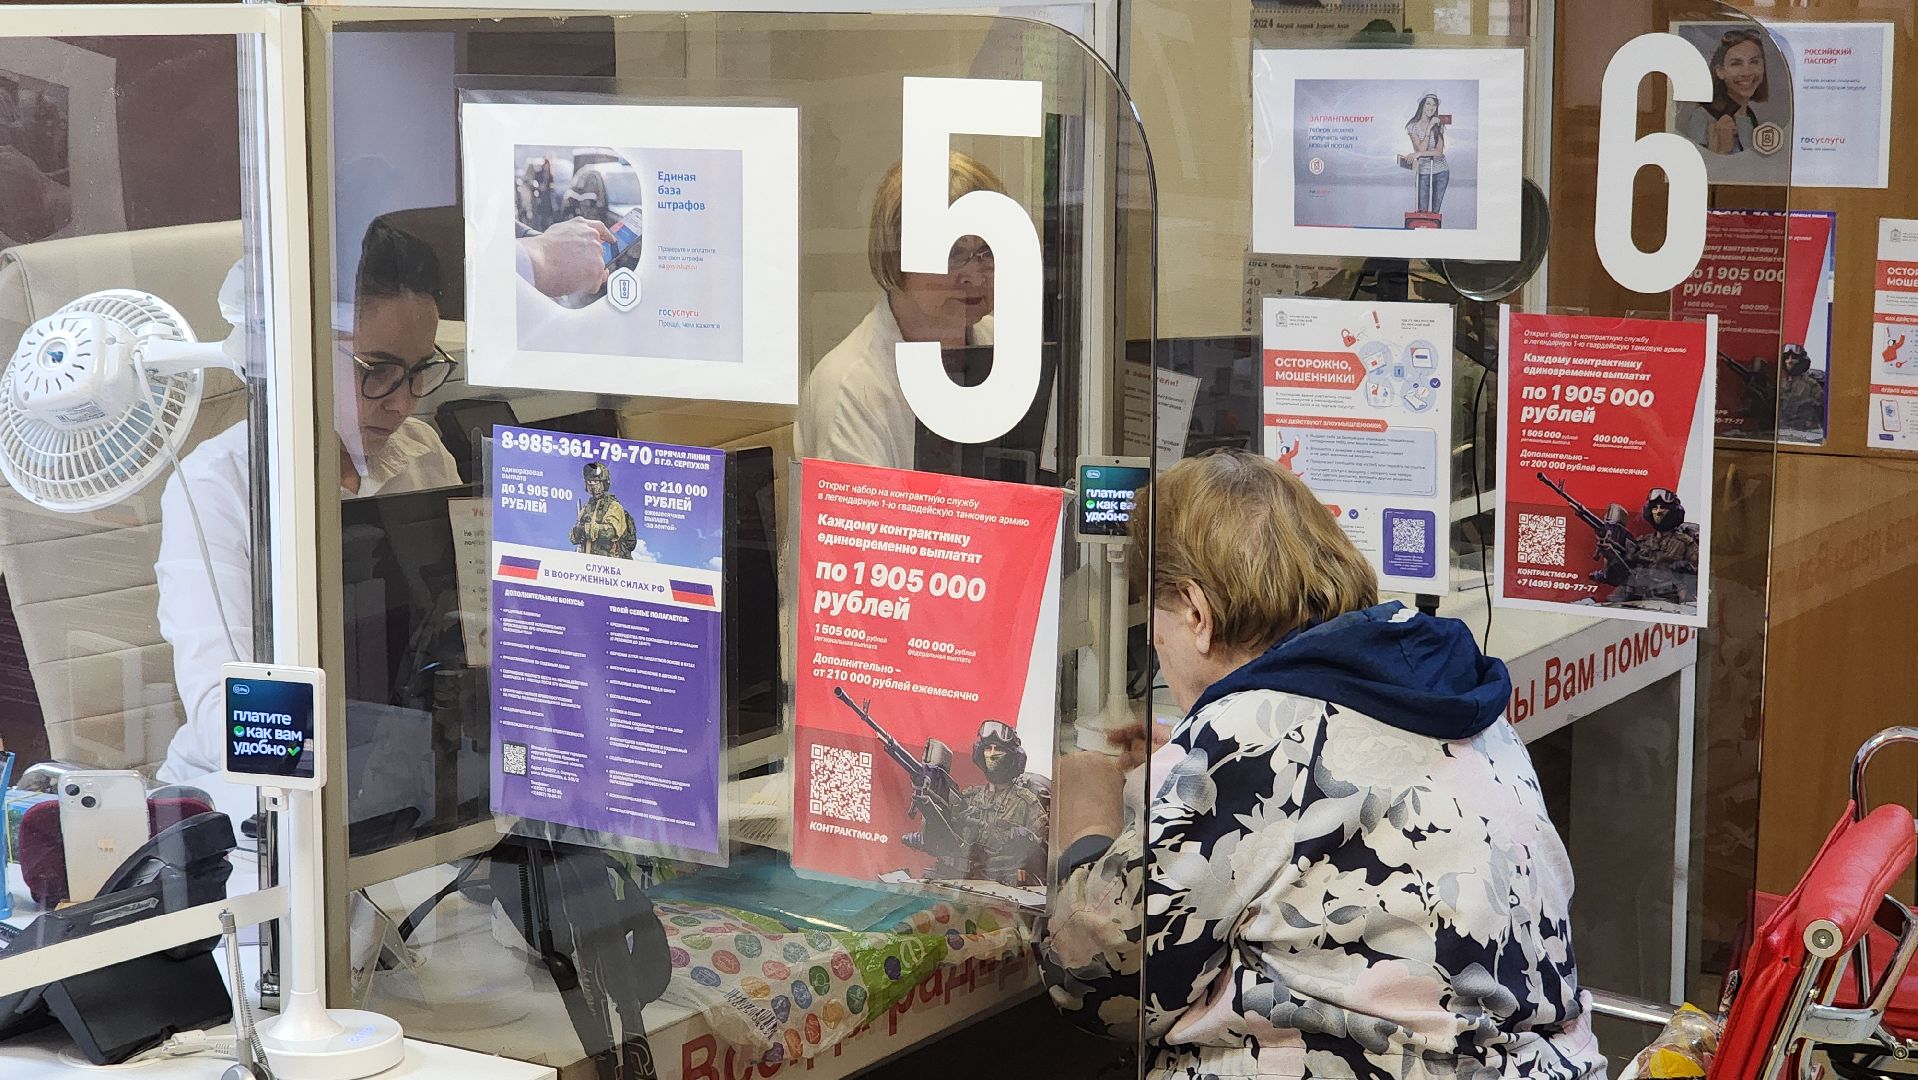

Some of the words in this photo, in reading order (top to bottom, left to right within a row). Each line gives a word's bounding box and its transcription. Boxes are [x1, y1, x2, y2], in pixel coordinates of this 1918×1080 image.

[1310, 115, 1375, 123] ЗАГРАНПАСПОРТ
[1595, 33, 1714, 293] 6
[658, 171, 696, 182] Единая
[658, 185, 682, 195] база
[658, 200, 706, 212] штрафов
[895, 77, 1043, 443] 5
[1706, 266, 1714, 279] 1
[1717, 268, 1750, 281] 905
[1682, 282, 1742, 296] рублей
[1524, 329, 1549, 338] Открыт
[1550, 332, 1570, 340] набор
[1580, 334, 1623, 342] контрактную
[1624, 336, 1650, 344] службу
[1529, 340, 1572, 348] легендарную
[1586, 343, 1630, 351] гвардейскую
[1630, 345, 1663, 353] танковую
[1275, 357, 1352, 372] ОСТОРОЖНО,
[1524, 353, 1572, 366] Каждому
[1572, 358, 1642, 370] контрактнику
[1276, 371, 1354, 384] МОШЕННИКИ!
[1524, 366, 1602, 378] единовременно
[1602, 372, 1652, 382] выплатят
[1522, 385, 1547, 400] по
[1552, 384, 1562, 400] 1
[1564, 385, 1606, 404] 905
[1610, 388, 1655, 408] 000
[1520, 404, 1596, 424] рублей
[1592, 434, 1612, 443] 400
[1611, 436, 1630, 444] 000
[502, 431, 652, 466] 8-985-361-79-70
[654, 449, 686, 459] ГОРЯЧАЯ
[687, 452, 711, 462] ЛИНИЯ
[1520, 449, 1582, 460] Дополнительно
[674, 460, 710, 470] СЕРПУХОВ
[1531, 460, 1548, 468] 200
[1548, 461, 1566, 470] 000
[1566, 463, 1596, 472] рублей
[1596, 466, 1648, 476] ежемесячно
[502, 484, 516, 494] до
[518, 483, 525, 494] 1
[526, 484, 549, 498] 905
[550, 487, 572, 500] 000
[644, 482, 658, 491] от
[660, 481, 682, 494] 210
[684, 484, 708, 497] 000
[818, 480, 850, 492] Открыт
[851, 484, 878, 497] набор
[878, 488, 889, 497] на
[890, 490, 946, 504] контрактную
[946, 496, 980, 510] службу
[1086, 488, 1135, 500] платите
[502, 496, 547, 514] РУБЛЕЙ
[644, 495, 692, 511] РУБЛЕЙ
[824, 494, 880, 508] легендарную
[881, 500, 896, 510] 1-ю
[898, 503, 954, 517] гвардейскую
[956, 510, 997, 524] танковую
[998, 515, 1030, 528] армию
[1096, 500, 1118, 510] как
[1085, 510, 1129, 523] удобно
[818, 514, 878, 536] Каждому
[879, 525, 971, 548] контрактнику
[818, 532, 918, 555] единовременно
[919, 547, 982, 564] выплатят
[585, 563, 622, 576] СЛУЖБА
[1517, 567, 1578, 580] КОНТРАКТМО.РФ
[544, 569, 550, 577] В
[551, 570, 618, 587] ВООРУЖЕННЫХ
[620, 579, 650, 592] СИЛАХ
[651, 584, 665, 593] РФ
[816, 560, 848, 582] по
[852, 561, 866, 586] 1
[870, 563, 924, 593] 905
[928, 572, 986, 602] 000
[1517, 578, 1528, 588] +7
[1528, 578, 1552, 590] (495)
[504, 589, 558, 603] ДОПОЛНИТЕЛЬНЫЕ
[558, 596, 585, 607] БОНУСЫ:
[813, 588, 911, 622] рублей
[609, 605, 629, 614] ТВОЕЙ
[629, 608, 650, 618] СЕМЬЕ
[650, 611, 690, 623] ПОЛАГАЕТСЯ:
[814, 634, 854, 647] региональная
[853, 641, 878, 650] выплата
[815, 624, 820, 634] 1
[821, 624, 844, 637] 505
[843, 628, 866, 640] 000
[866, 635, 888, 644] рублей
[907, 638, 931, 650] 400
[931, 641, 955, 654] 000
[954, 648, 977, 658] рублей
[813, 652, 894, 674] Дополнительно
[907, 649, 947, 660] федеральная
[946, 654, 972, 664] выплата
[813, 668, 826, 678] от
[826, 668, 848, 682] 210
[849, 672, 872, 685] 000
[872, 676, 911, 692] рублей
[912, 683, 979, 702] ежемесячно
[1544, 652, 1596, 710] Вам
[233, 710, 292, 726] платите
[246, 726, 273, 740] как
[274, 729, 302, 742] вам
[233, 739, 286, 756] удобно
[809, 821, 888, 844] КОНТРАКТМО.РФ
